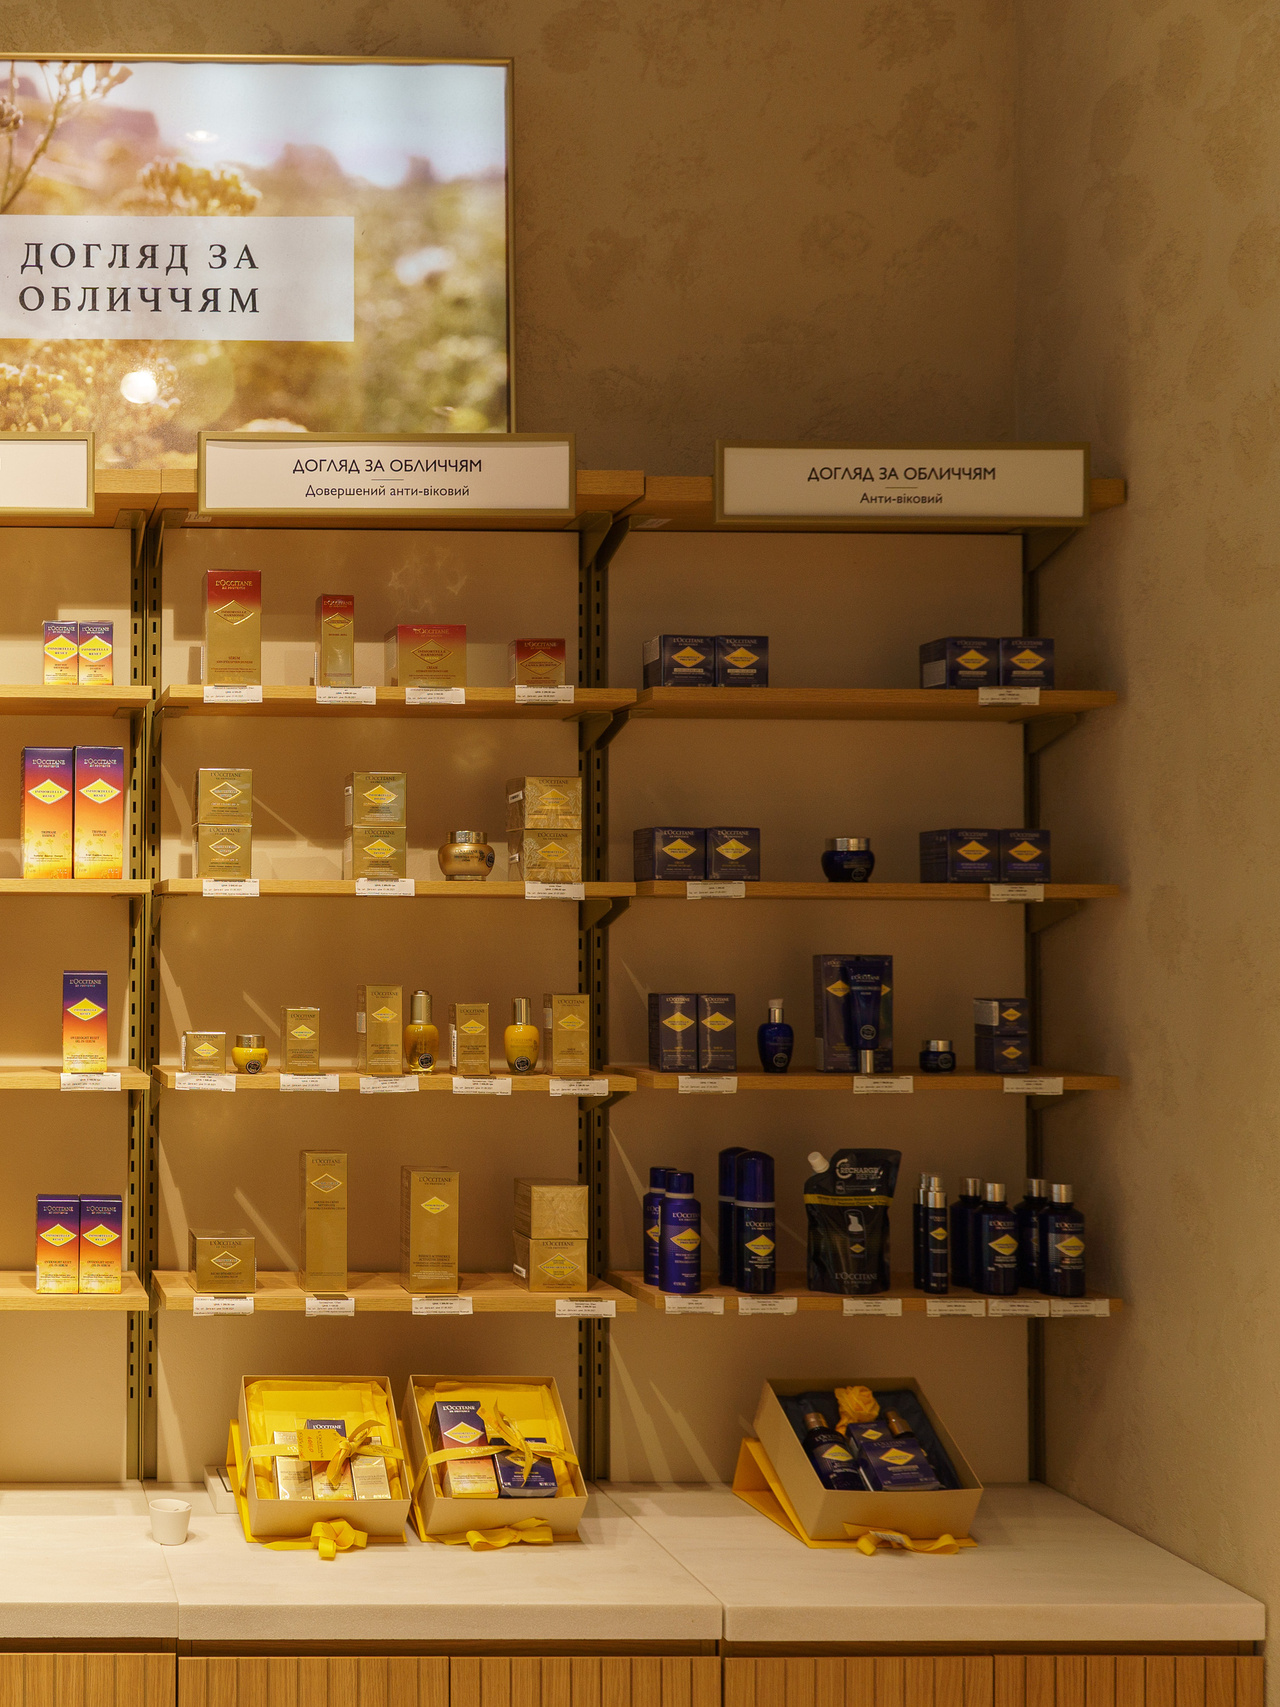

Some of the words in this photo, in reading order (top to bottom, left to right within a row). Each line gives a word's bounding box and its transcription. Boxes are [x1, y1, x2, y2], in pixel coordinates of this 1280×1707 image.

[20, 243, 188, 275] ДОГЛЯД
[208, 243, 259, 270] ЗА
[19, 286, 260, 313] ОБЛИЧЧЯМ
[293, 459, 360, 474] ДОГЛЯД
[365, 459, 385, 472] ЗА
[390, 459, 482, 473] ОБЛИЧЧЯМ
[807, 467, 874, 482] ДОГЛЯД
[879, 467, 899, 480] ЗА
[904, 467, 996, 481] ОБЛИЧЧЯМ
[305, 484, 386, 499] Довершений
[390, 485, 470, 497] анти-віковий
[859, 492, 943, 504] Анти-віковий
[215, 579, 253, 587] L'OCCITANE
